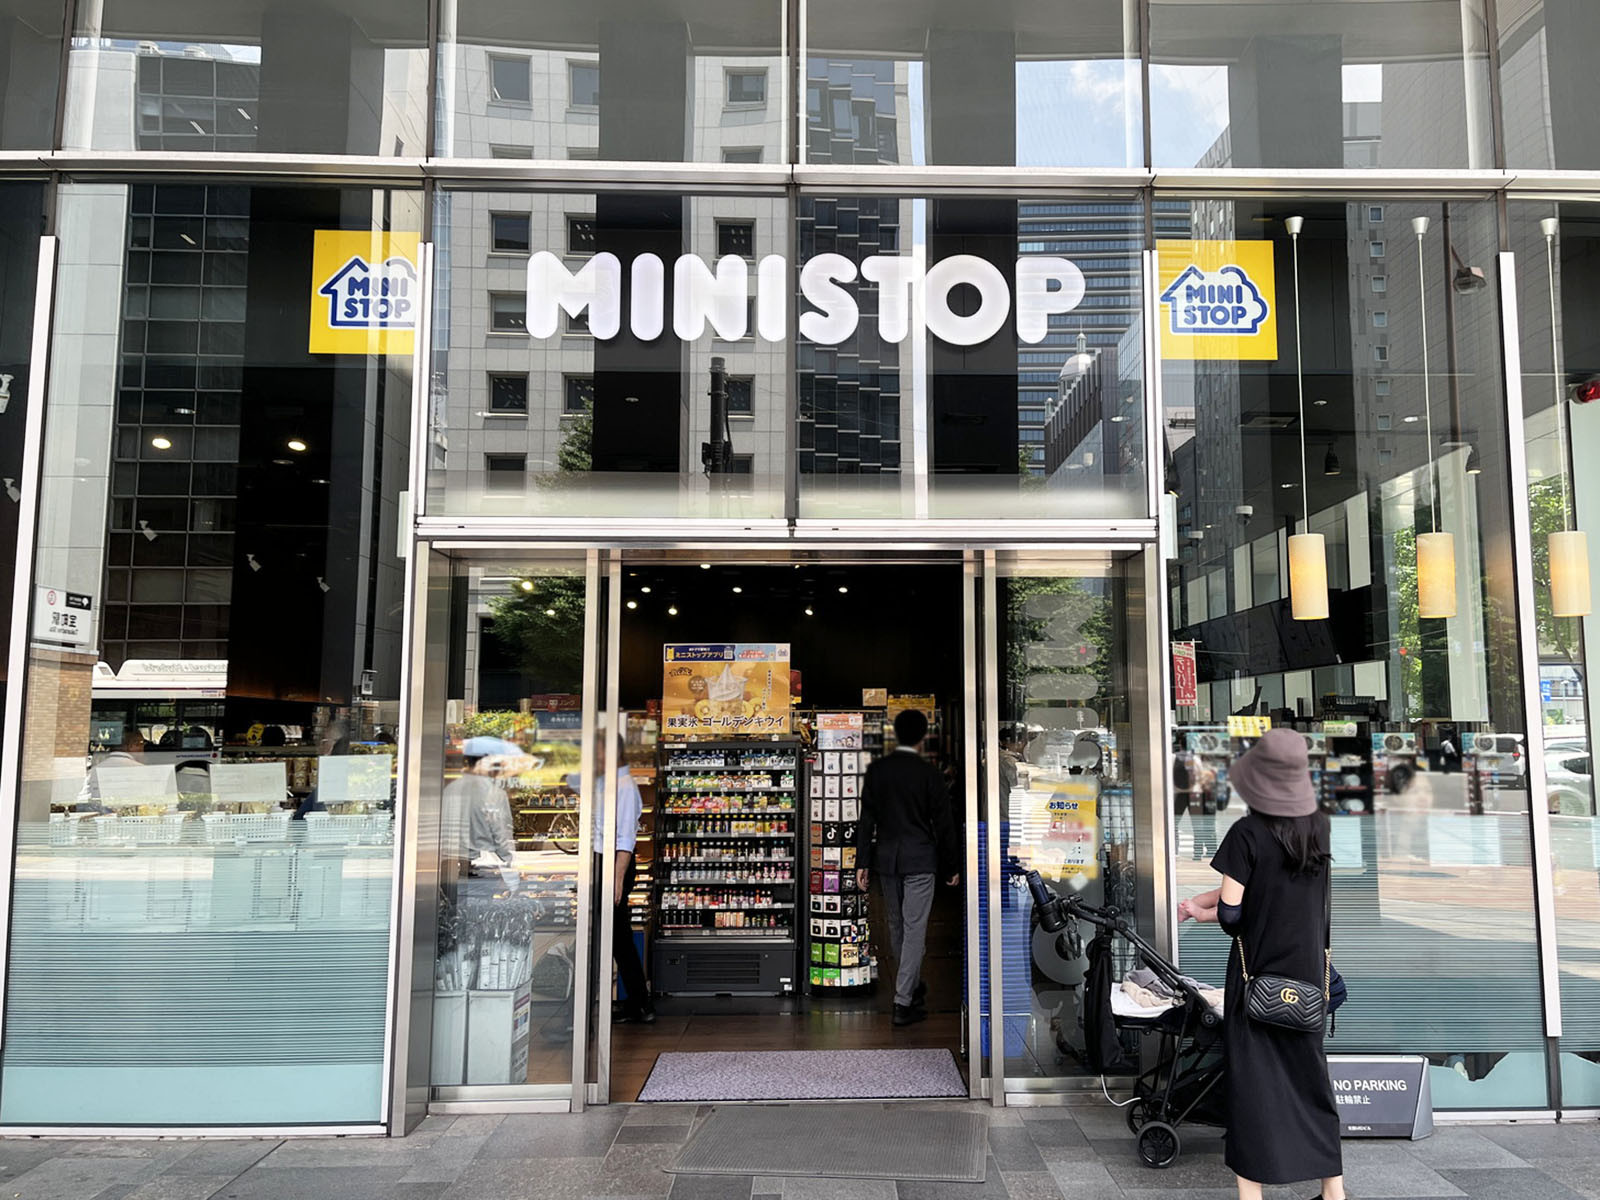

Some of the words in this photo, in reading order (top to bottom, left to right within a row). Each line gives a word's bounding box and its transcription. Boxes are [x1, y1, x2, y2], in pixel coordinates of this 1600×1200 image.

[348, 276, 408, 298] MINI
[1185, 284, 1243, 304] MINI
[343, 297, 411, 319] STOP
[526, 250, 1086, 346] MINISTOP
[1183, 304, 1247, 326] STOP
[667, 716, 699, 728] 果実氷
[703, 715, 785, 728] ゴールデンキウイ
[1049, 801, 1079, 810] お知らせ
[1333, 1080, 1352, 1091] NO
[1354, 1080, 1407, 1091] PARKING
